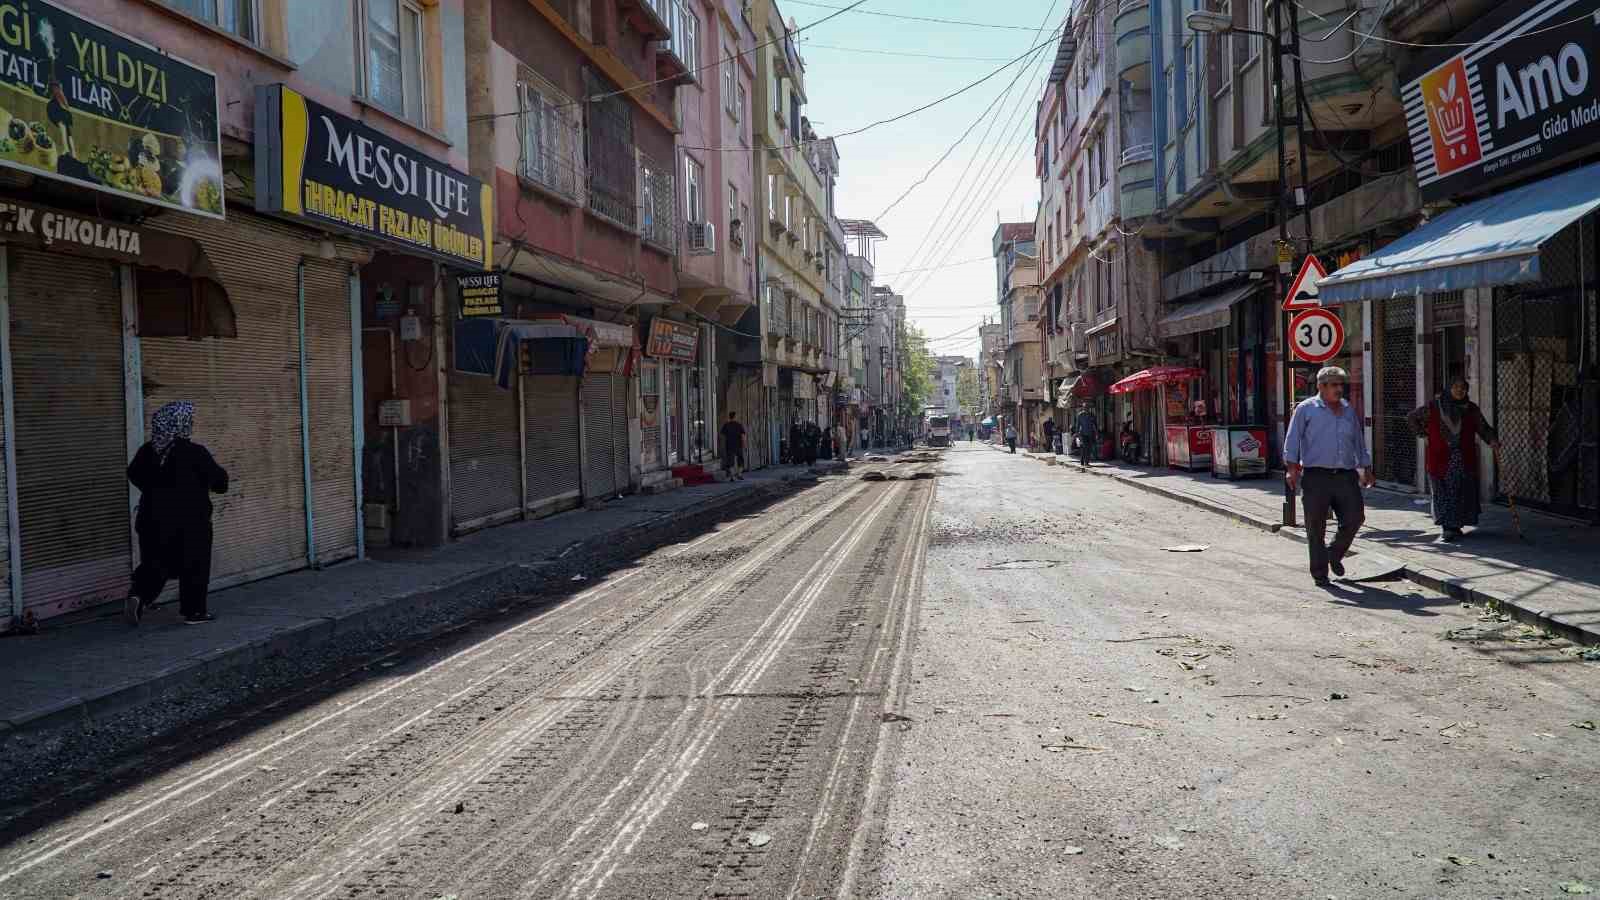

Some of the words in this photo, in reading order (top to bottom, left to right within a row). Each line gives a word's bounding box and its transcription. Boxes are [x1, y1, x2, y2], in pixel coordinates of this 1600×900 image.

[70, 32, 168, 103] YILDIZI
[1496, 42, 1589, 129] Amo
[321, 115, 418, 197] MESSI
[425, 165, 470, 219] LIFE
[379, 203, 432, 250] FAZLASI
[1299, 323, 1333, 348] 30
